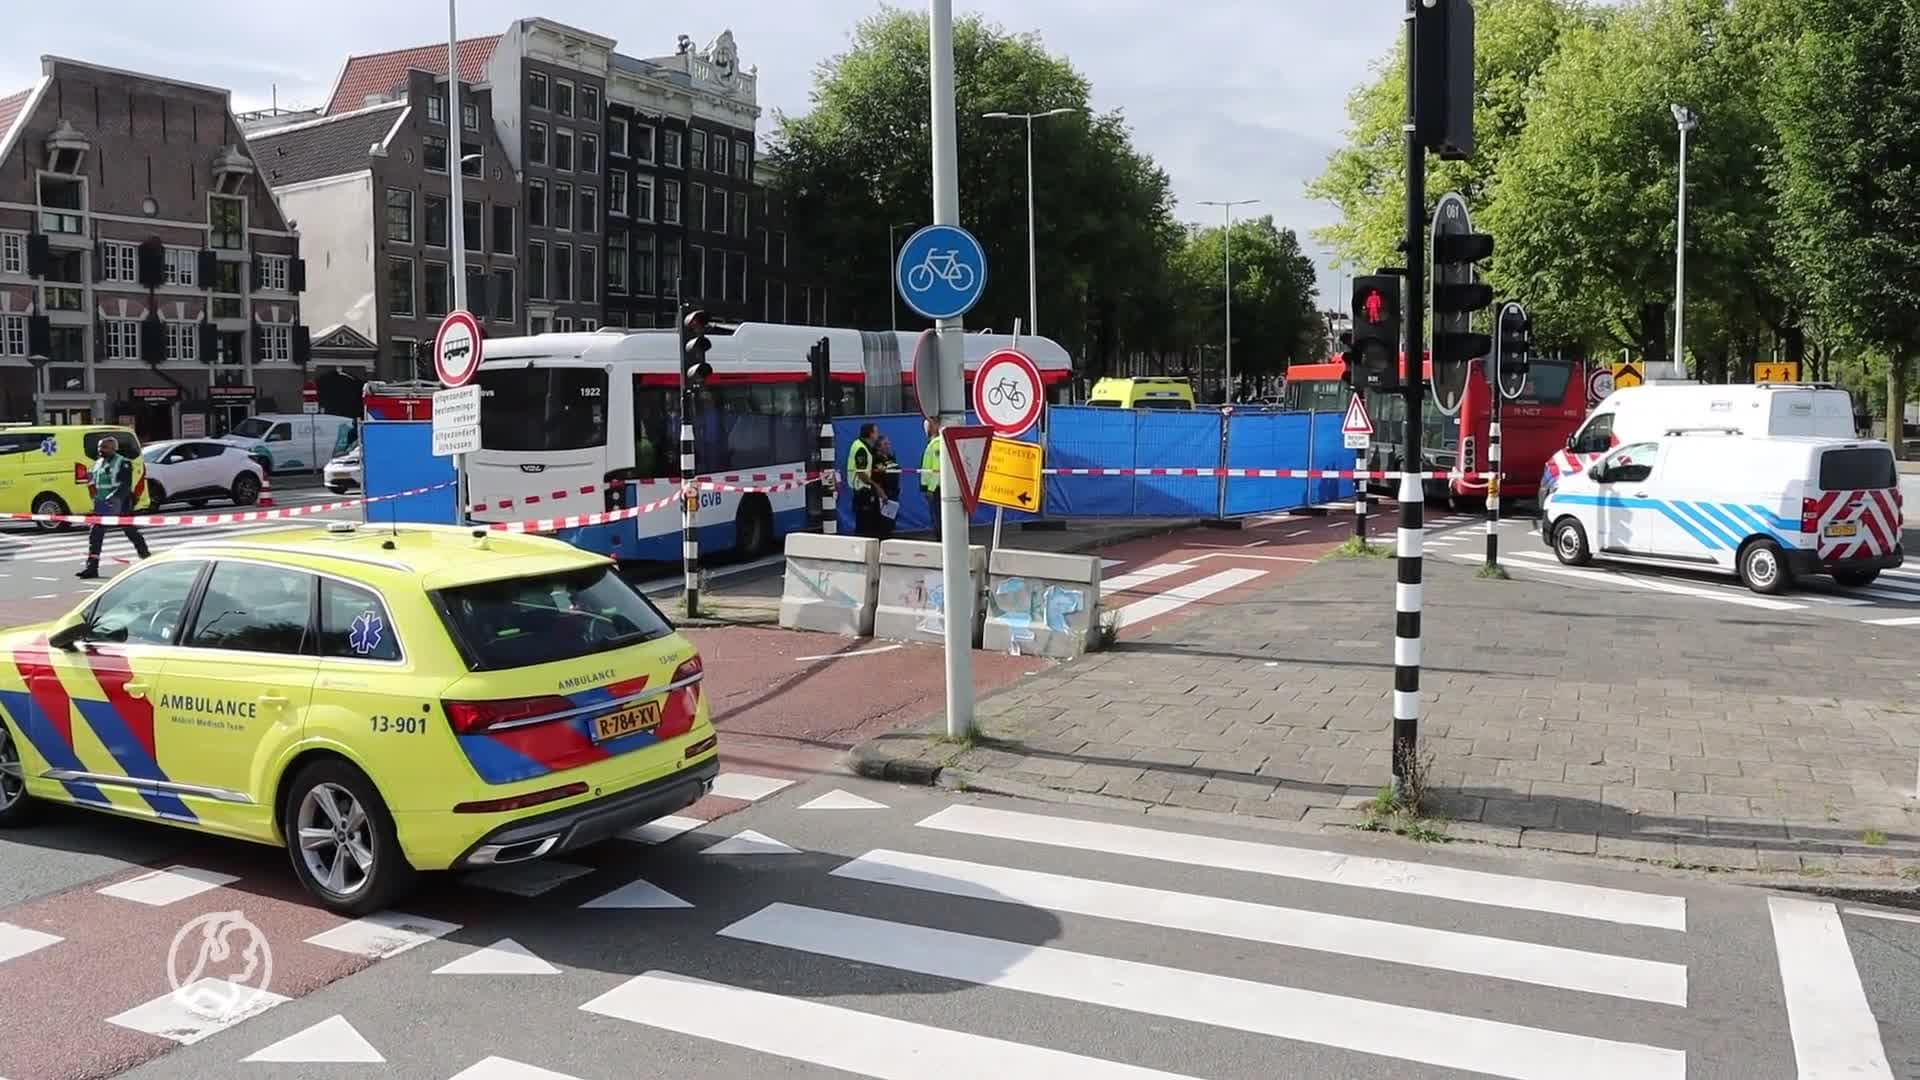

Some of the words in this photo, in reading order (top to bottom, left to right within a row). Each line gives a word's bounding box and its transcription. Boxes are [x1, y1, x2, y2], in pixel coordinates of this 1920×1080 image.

[580, 388, 601, 397] 1922
[701, 492, 721, 507] GVB
[558, 669, 616, 689] AMBULANCE
[160, 694, 256, 718] AMBULANCE
[226, 722, 245, 732] Team
[370, 716, 428, 734] 13-901
[600, 706, 655, 736] R-784-XV
